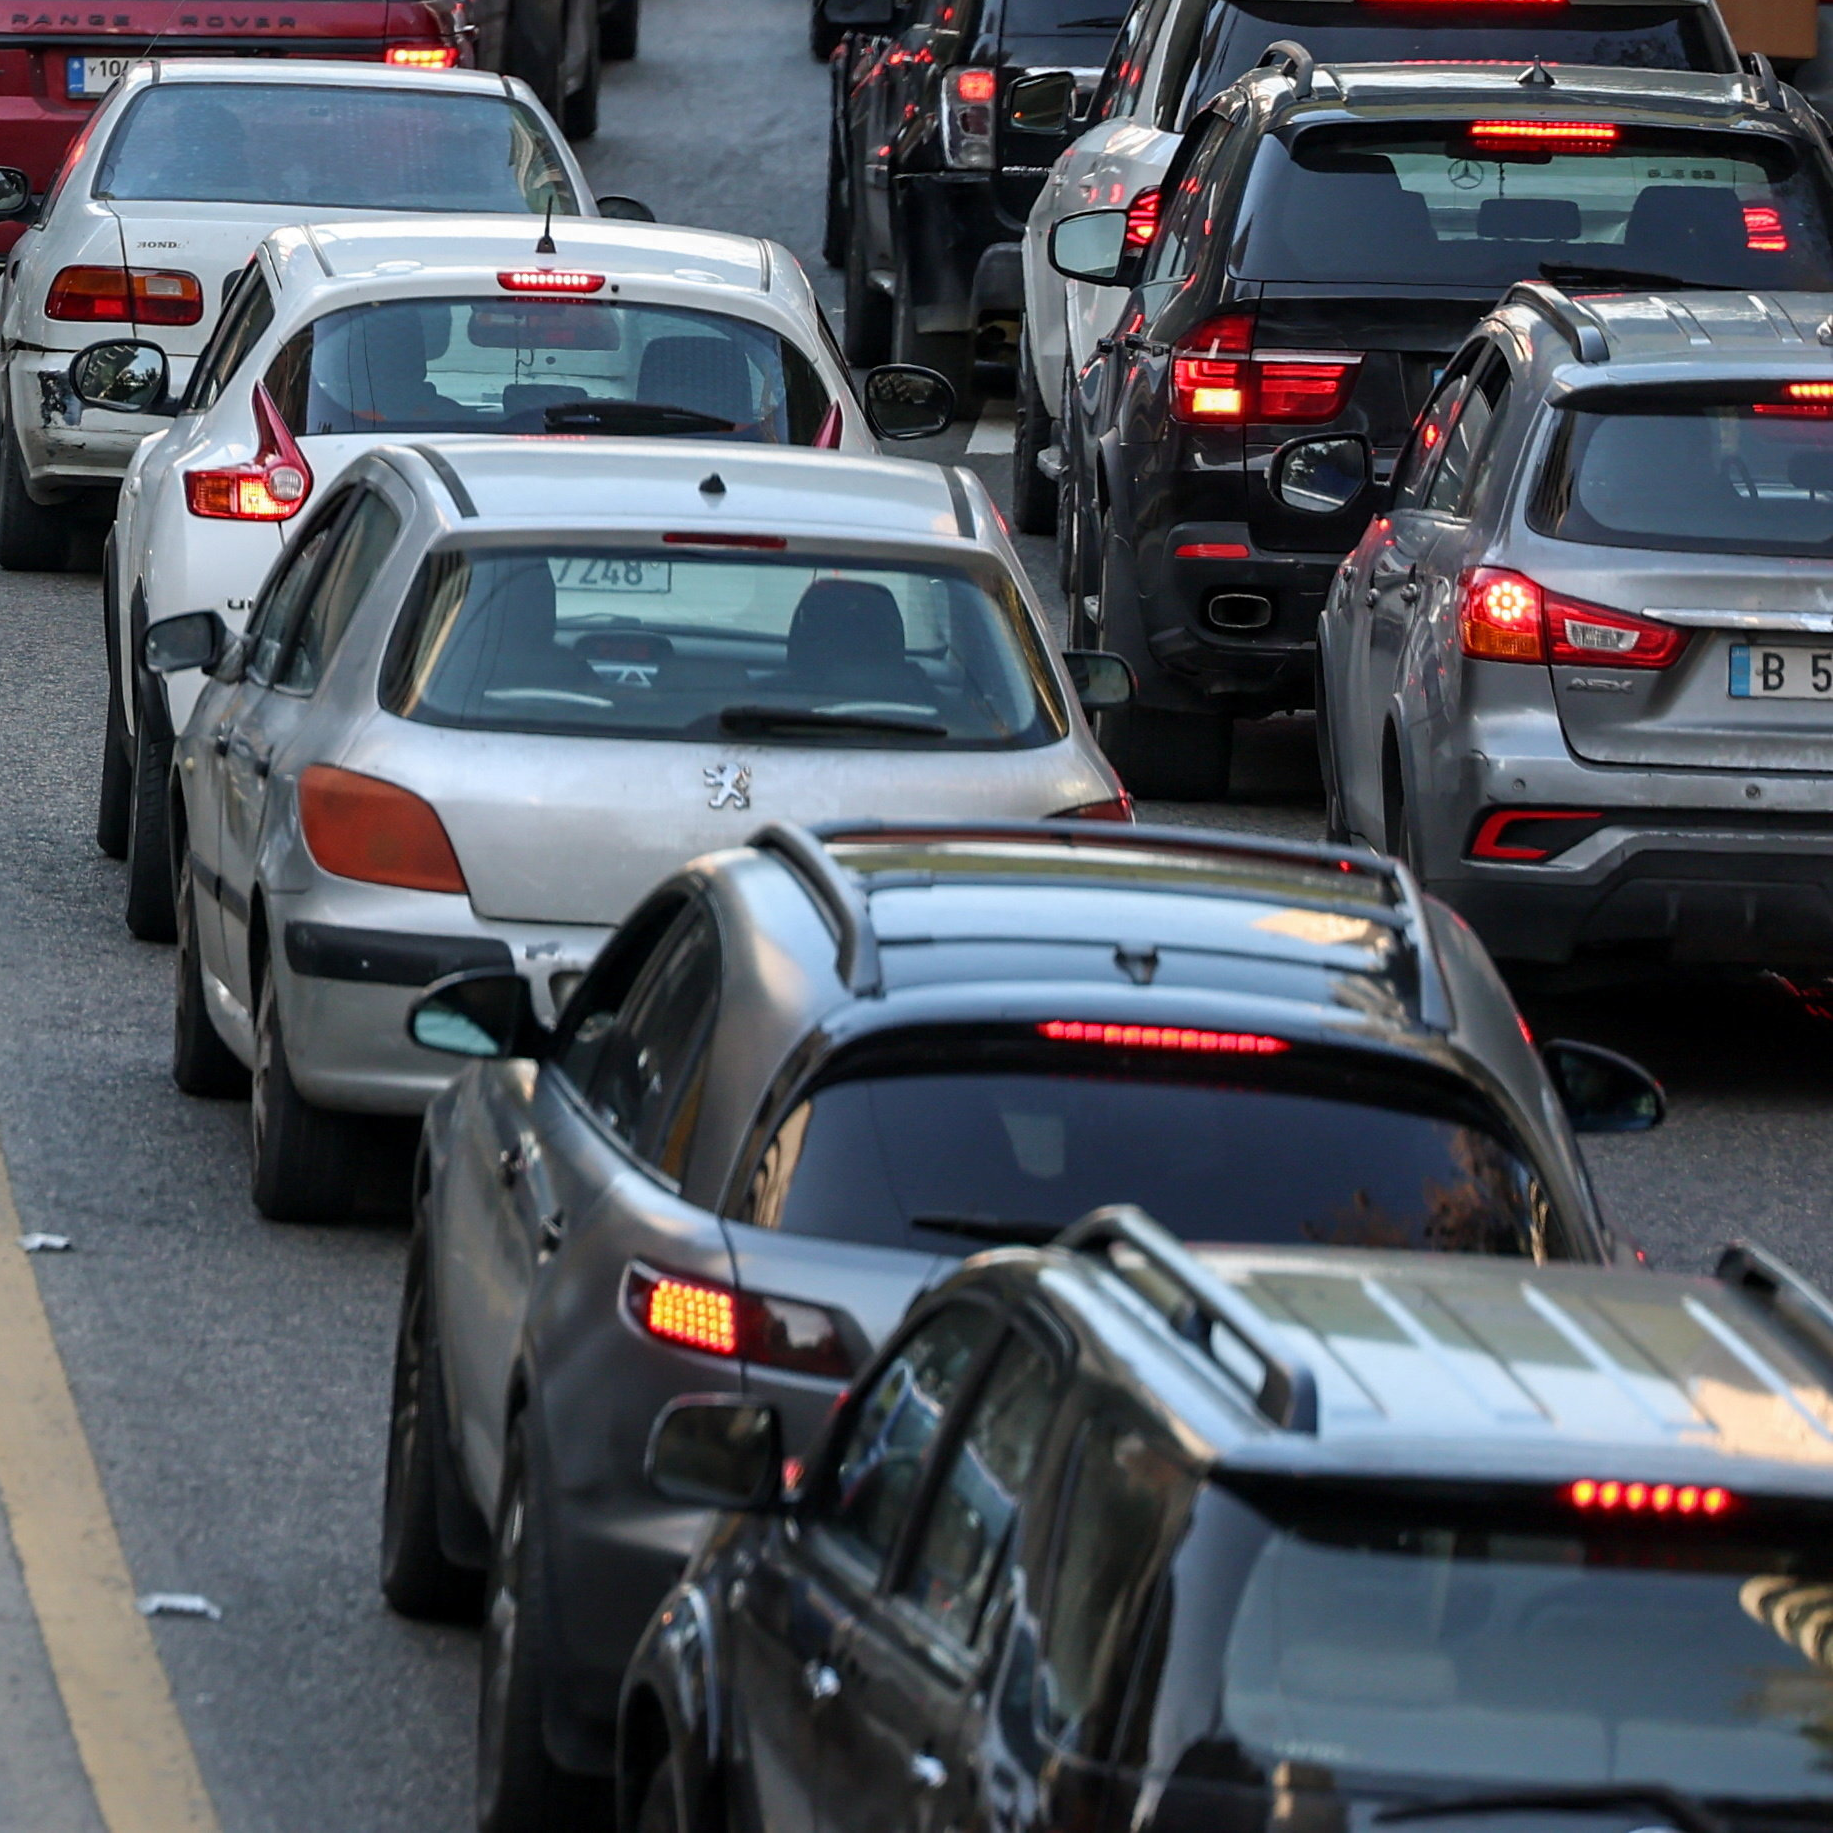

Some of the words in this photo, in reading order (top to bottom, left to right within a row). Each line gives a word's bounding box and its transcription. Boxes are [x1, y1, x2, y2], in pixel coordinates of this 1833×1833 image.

[11, 13, 131, 28] RANGE
[180, 14, 298, 28] ROVER
[1761, 652, 1785, 692] B
